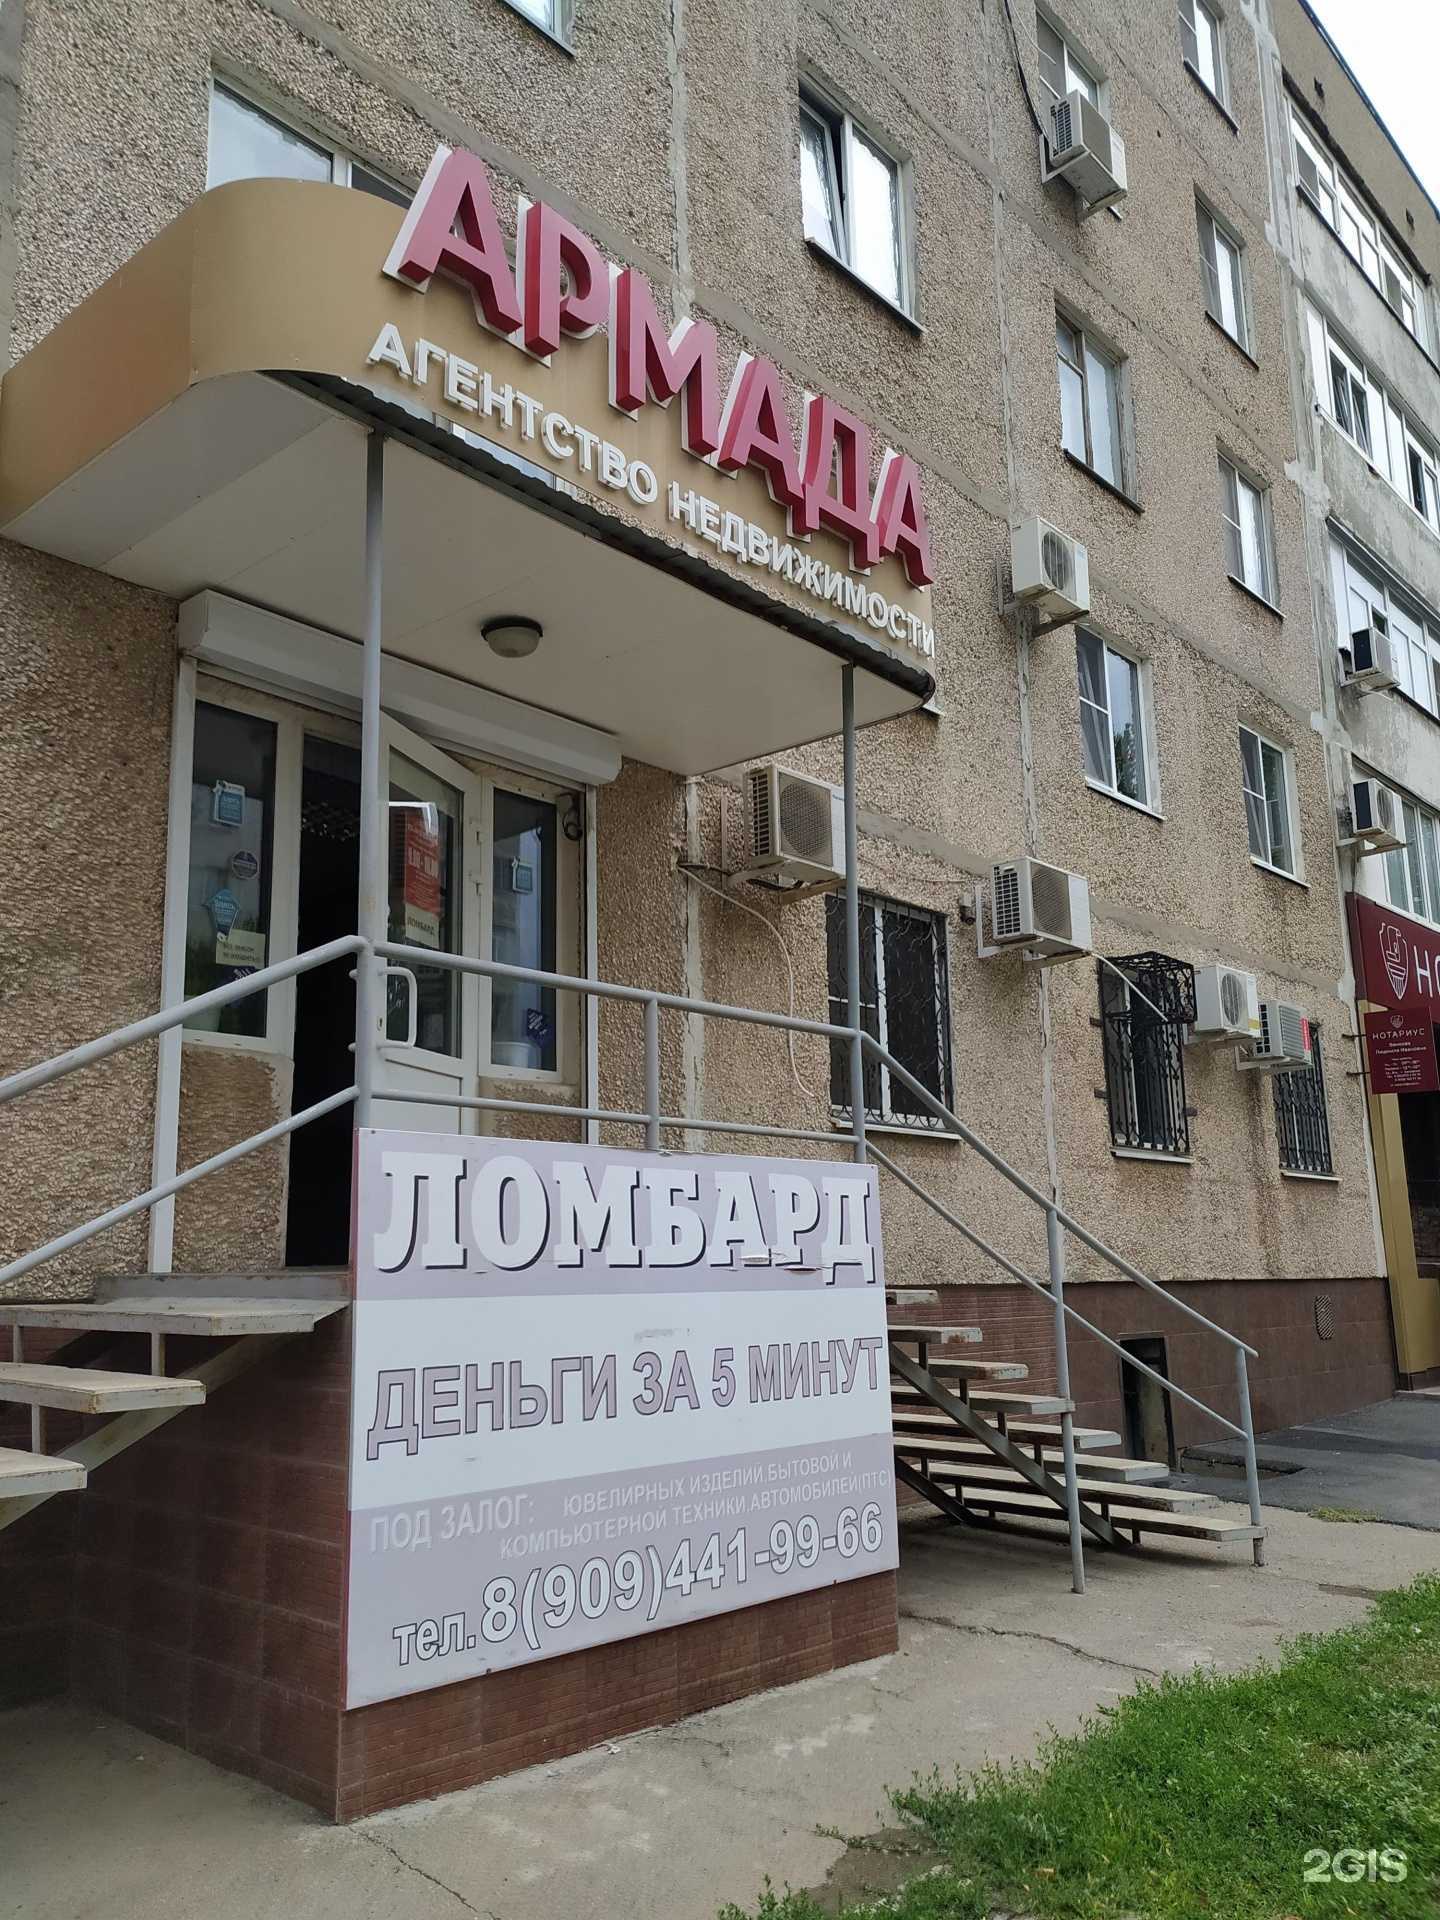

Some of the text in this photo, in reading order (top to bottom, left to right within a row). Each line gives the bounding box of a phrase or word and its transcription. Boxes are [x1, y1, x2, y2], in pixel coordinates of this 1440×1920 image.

[385, 145, 934, 591] АРМАДА
[366, 322, 935, 658] АГЕНТСТВО НЕДВИЖИМОСТИ
[1372, 1028, 1425, 1040] НОТАРИУС
[373, 1150, 877, 1285] ЛОМБАРД
[366, 1337, 883, 1461] ДЕНЬГИ ЗА 5 МИНУТ
[369, 1493, 535, 1552] ПОД ЗАЛОГ:
[501, 1505, 666, 1560] КОМПЬЮТЕРНОЙ
[563, 1479, 685, 1516] ЮВЕЛИРНЫХ
[841, 1451, 852, 1468] И
[481, 1502, 882, 1649] 8(909)441-99-66
